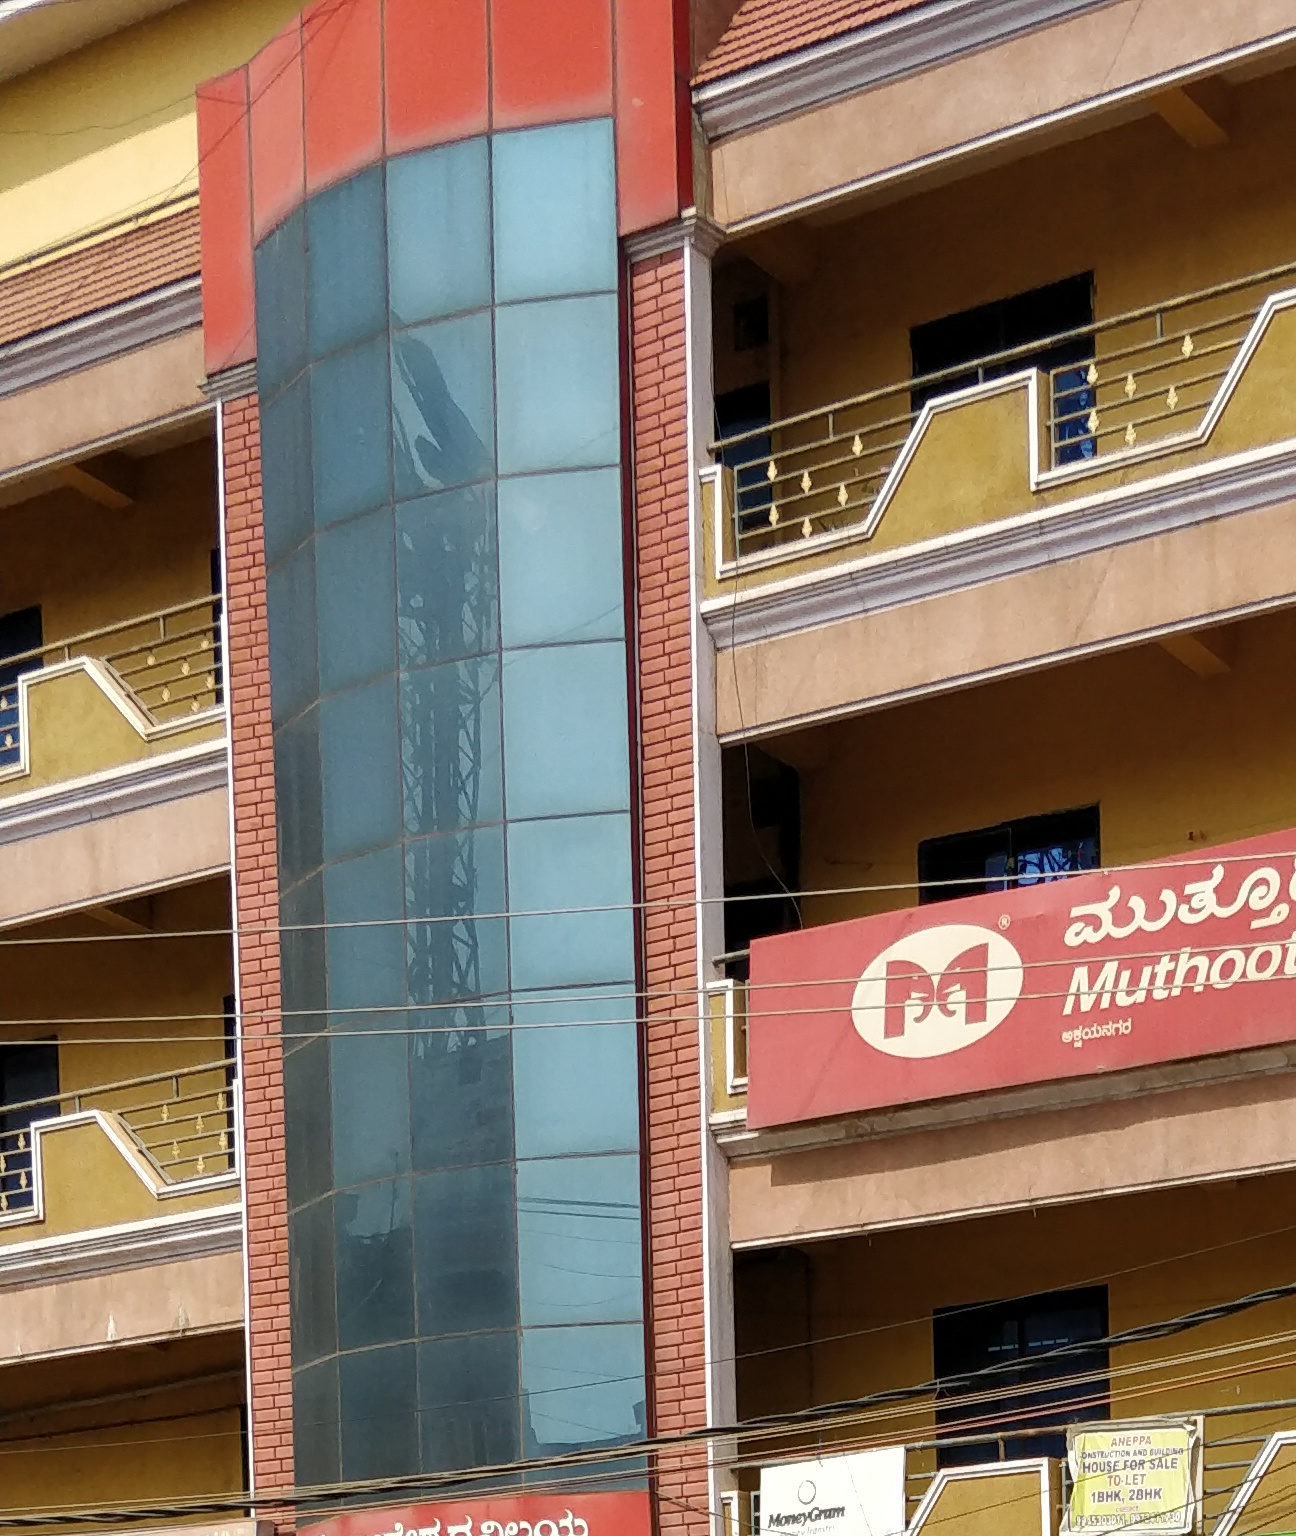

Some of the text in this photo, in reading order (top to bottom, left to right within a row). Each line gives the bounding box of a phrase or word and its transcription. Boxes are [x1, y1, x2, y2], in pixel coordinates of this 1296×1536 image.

[1111, 1435, 1152, 1447] ANEPPA
[1080, 1447, 1184, 1459] ONSTRUCTION AND BUILDING
[1082, 1458, 1178, 1473] HOUSE FOR SALE
[1129, 1488, 1162, 1501] 2BHK
[768, 1506, 846, 1528] MoneyGram
